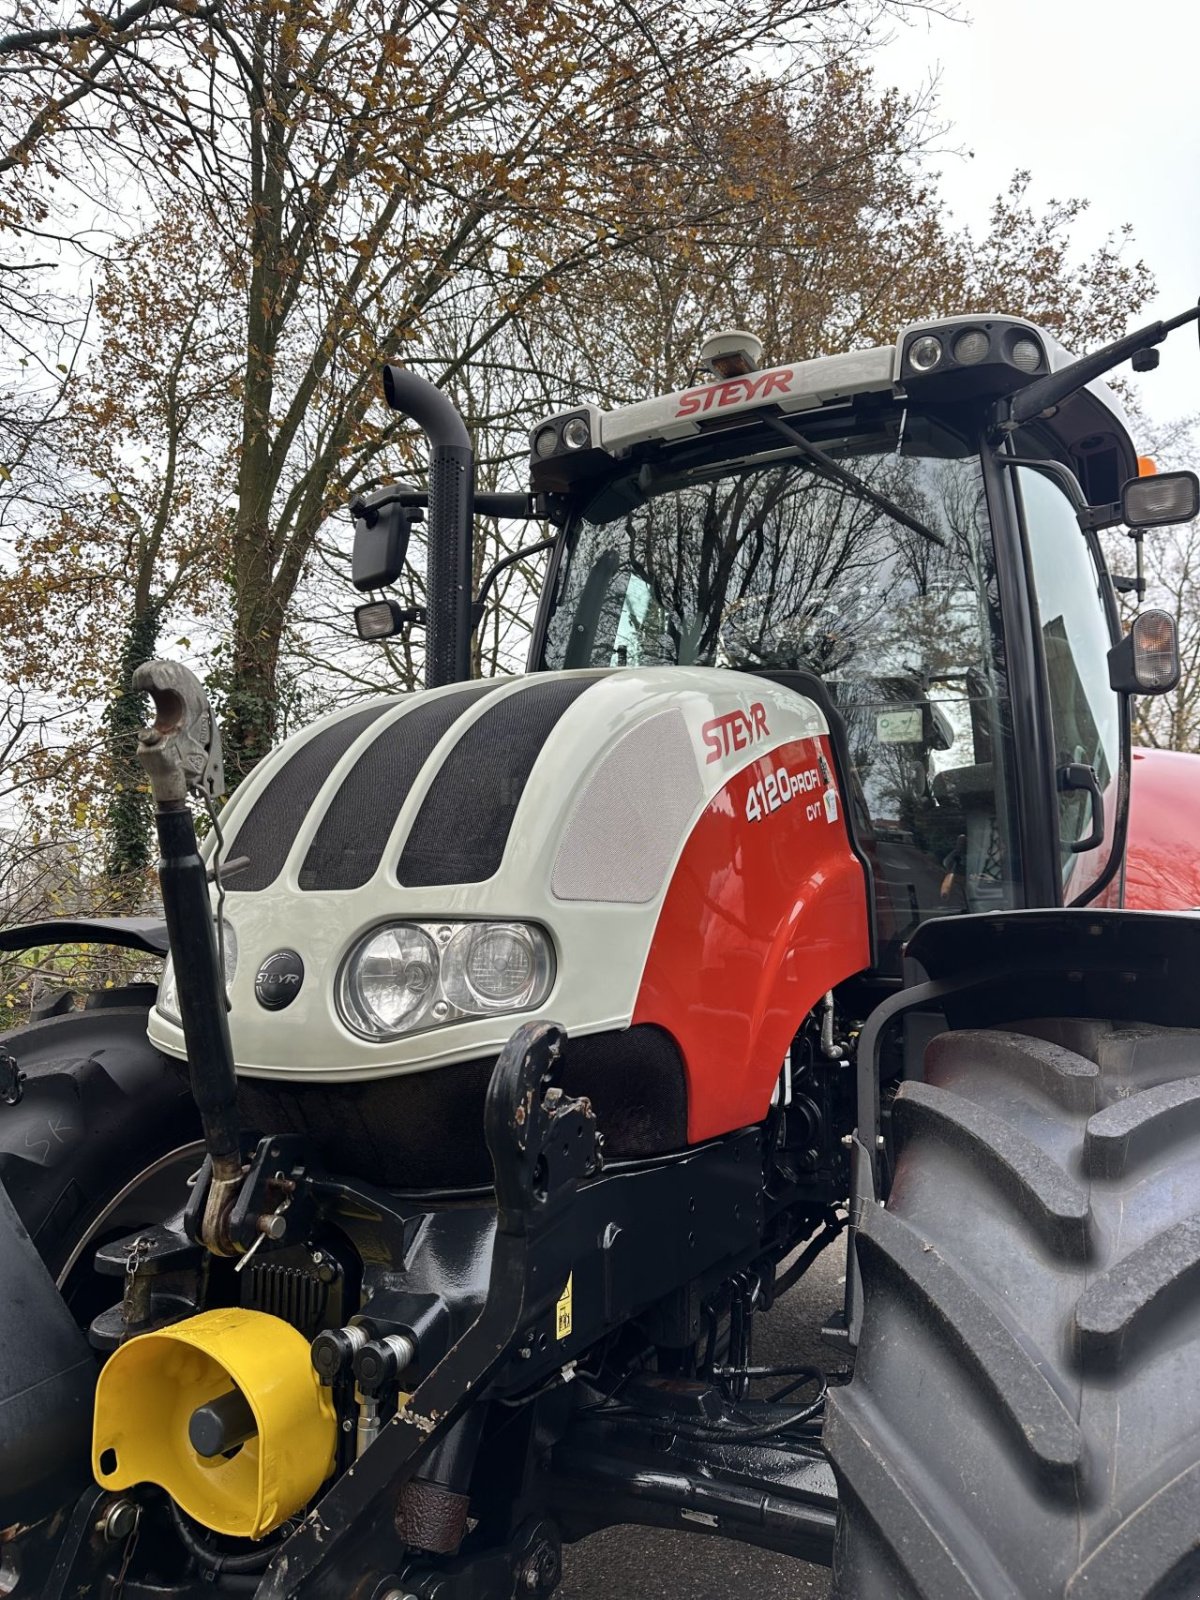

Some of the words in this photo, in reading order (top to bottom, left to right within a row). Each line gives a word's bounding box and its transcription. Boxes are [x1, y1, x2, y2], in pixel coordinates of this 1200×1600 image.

[675, 369, 794, 418] STEYR
[702, 702, 770, 765] STEYR
[745, 767, 792, 823] 4120
[789, 769, 821, 798] PROFI
[806, 801, 821, 821] CVT
[255, 972, 300, 985] STEYR
